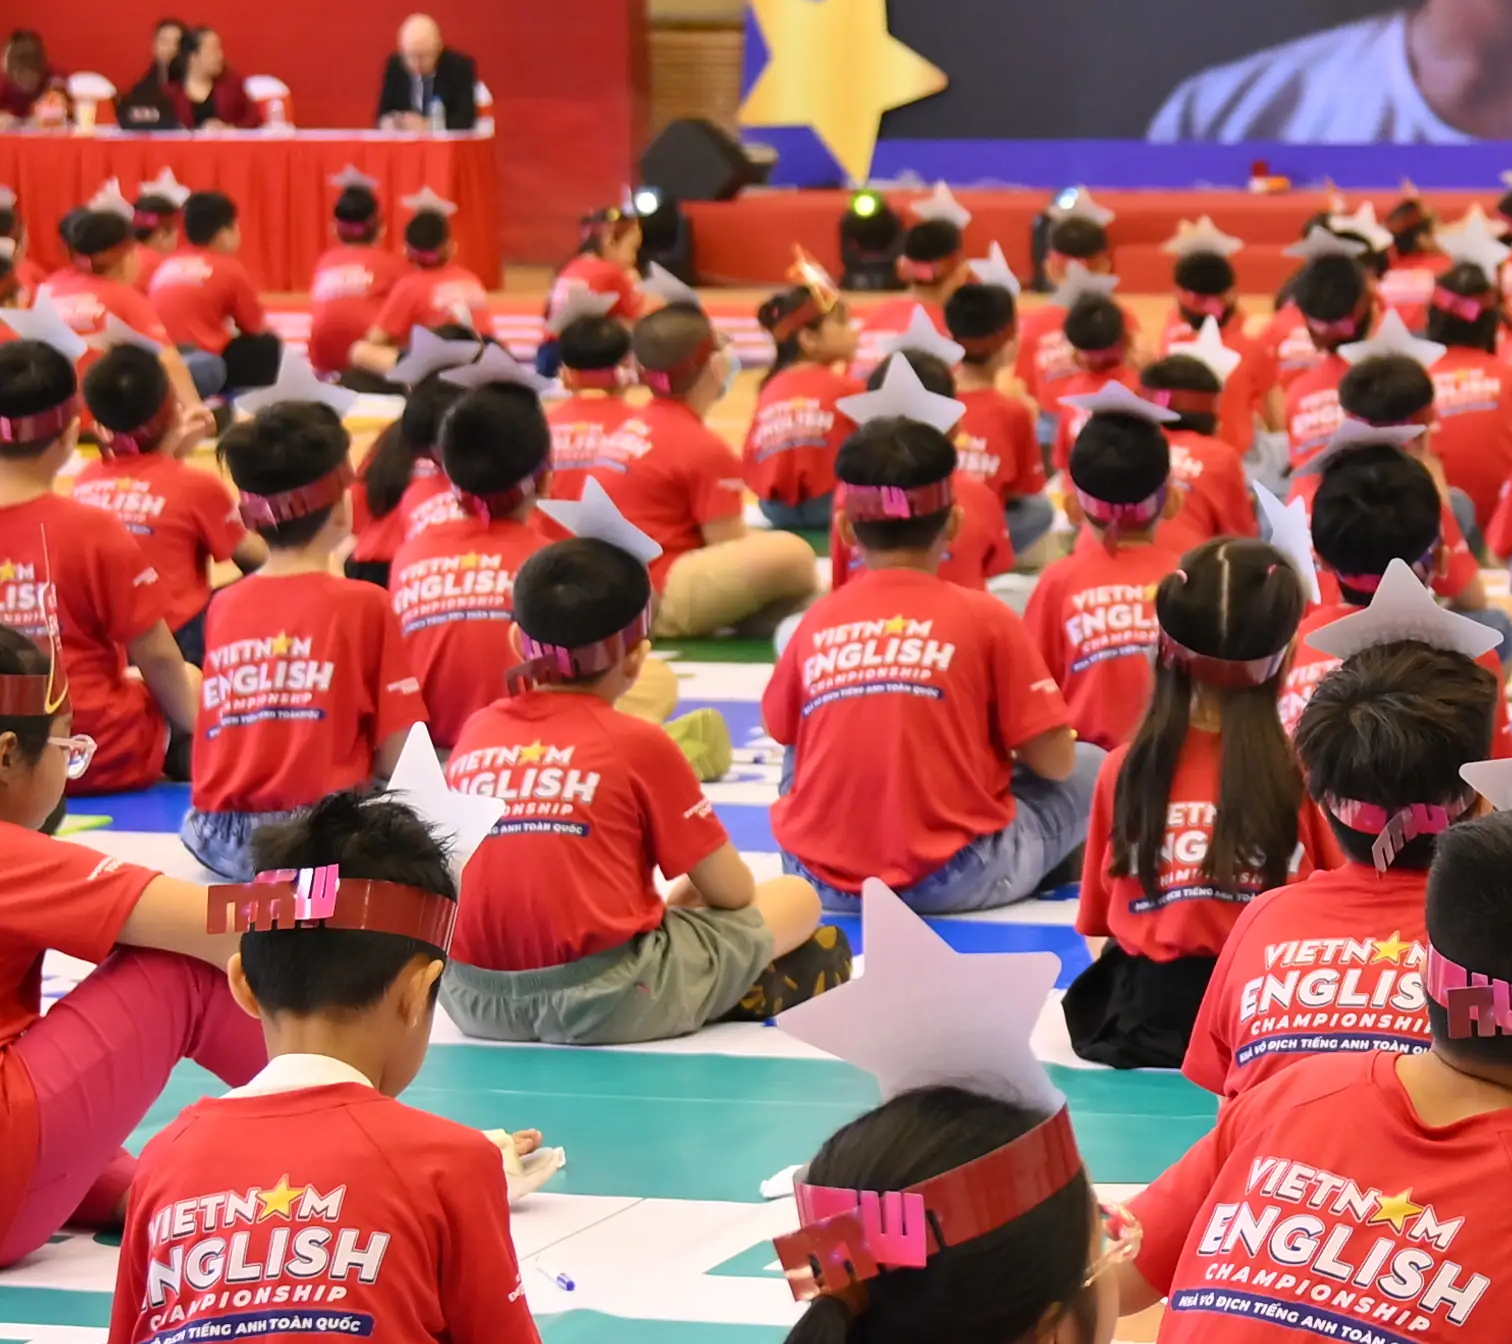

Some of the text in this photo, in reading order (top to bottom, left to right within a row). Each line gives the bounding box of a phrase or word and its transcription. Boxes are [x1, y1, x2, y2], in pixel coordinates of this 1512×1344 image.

[392, 570, 516, 618] ENGLISH
[202, 660, 335, 711] ENGLISH
[803, 637, 956, 689] ENGLISH
[501, 820, 583, 836] ANH TOÀN QUỐC
[1240, 968, 1427, 1021] ENGLIS
[1251, 1013, 1430, 1036] CHAMPIONSHI
[1267, 1037, 1296, 1054] ĐỊCH
[1300, 1032, 1337, 1051] TIẾNG
[1340, 1039, 1369, 1051] ANH
[1372, 1035, 1409, 1053] TOÀN
[138, 1225, 388, 1311] NGLISH
[1198, 1202, 1491, 1328] ENGLISH
[1205, 1262, 1431, 1333] CHAMPIONSHIP
[1217, 1293, 1252, 1319] ĐỊCH
[1254, 1299, 1303, 1330] TIẾNG
[1304, 1317, 1341, 1340] ANH
[188, 1311, 361, 1340] TIẾNG ANH TOÀN QUỐC
